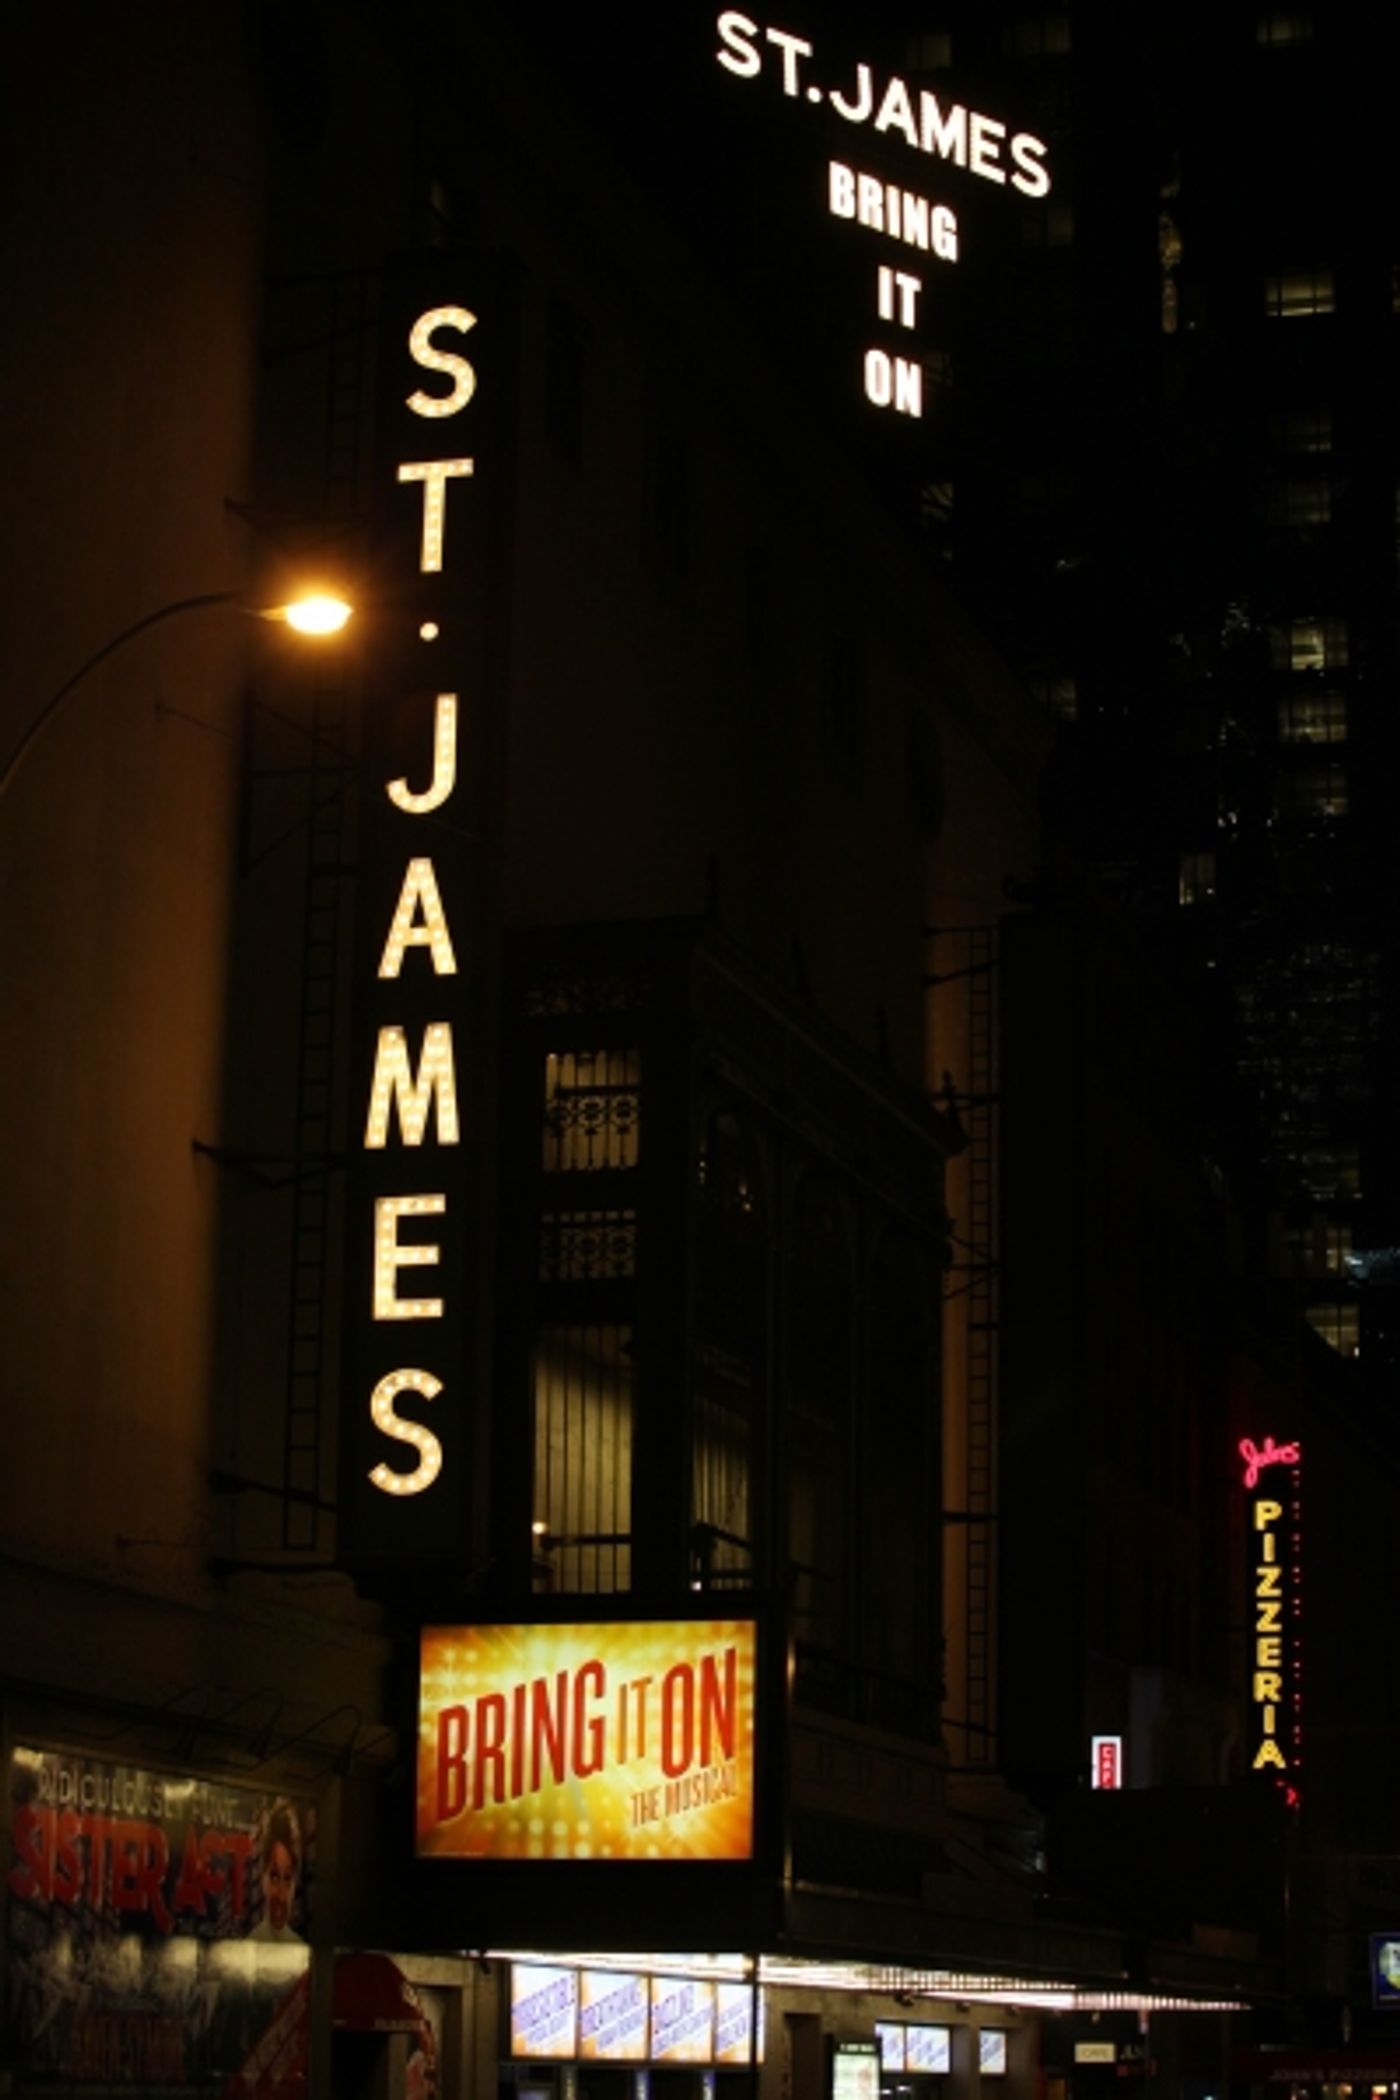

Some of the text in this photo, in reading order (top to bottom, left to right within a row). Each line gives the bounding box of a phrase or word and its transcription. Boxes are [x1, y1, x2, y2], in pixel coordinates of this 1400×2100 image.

[716, 10, 1051, 198] ST. JAMES
[828, 160, 958, 263] BRING
[878, 265, 922, 330] IT
[864, 348, 922, 418] ON
[364, 693, 460, 1496] JAMES
[1252, 1500, 1286, 1769] PIZZERIA
[437, 1646, 737, 1823] BRING IT ON
[631, 1764, 738, 1827] THE MUSICAL
[8, 1803, 175, 1933] SISTER
